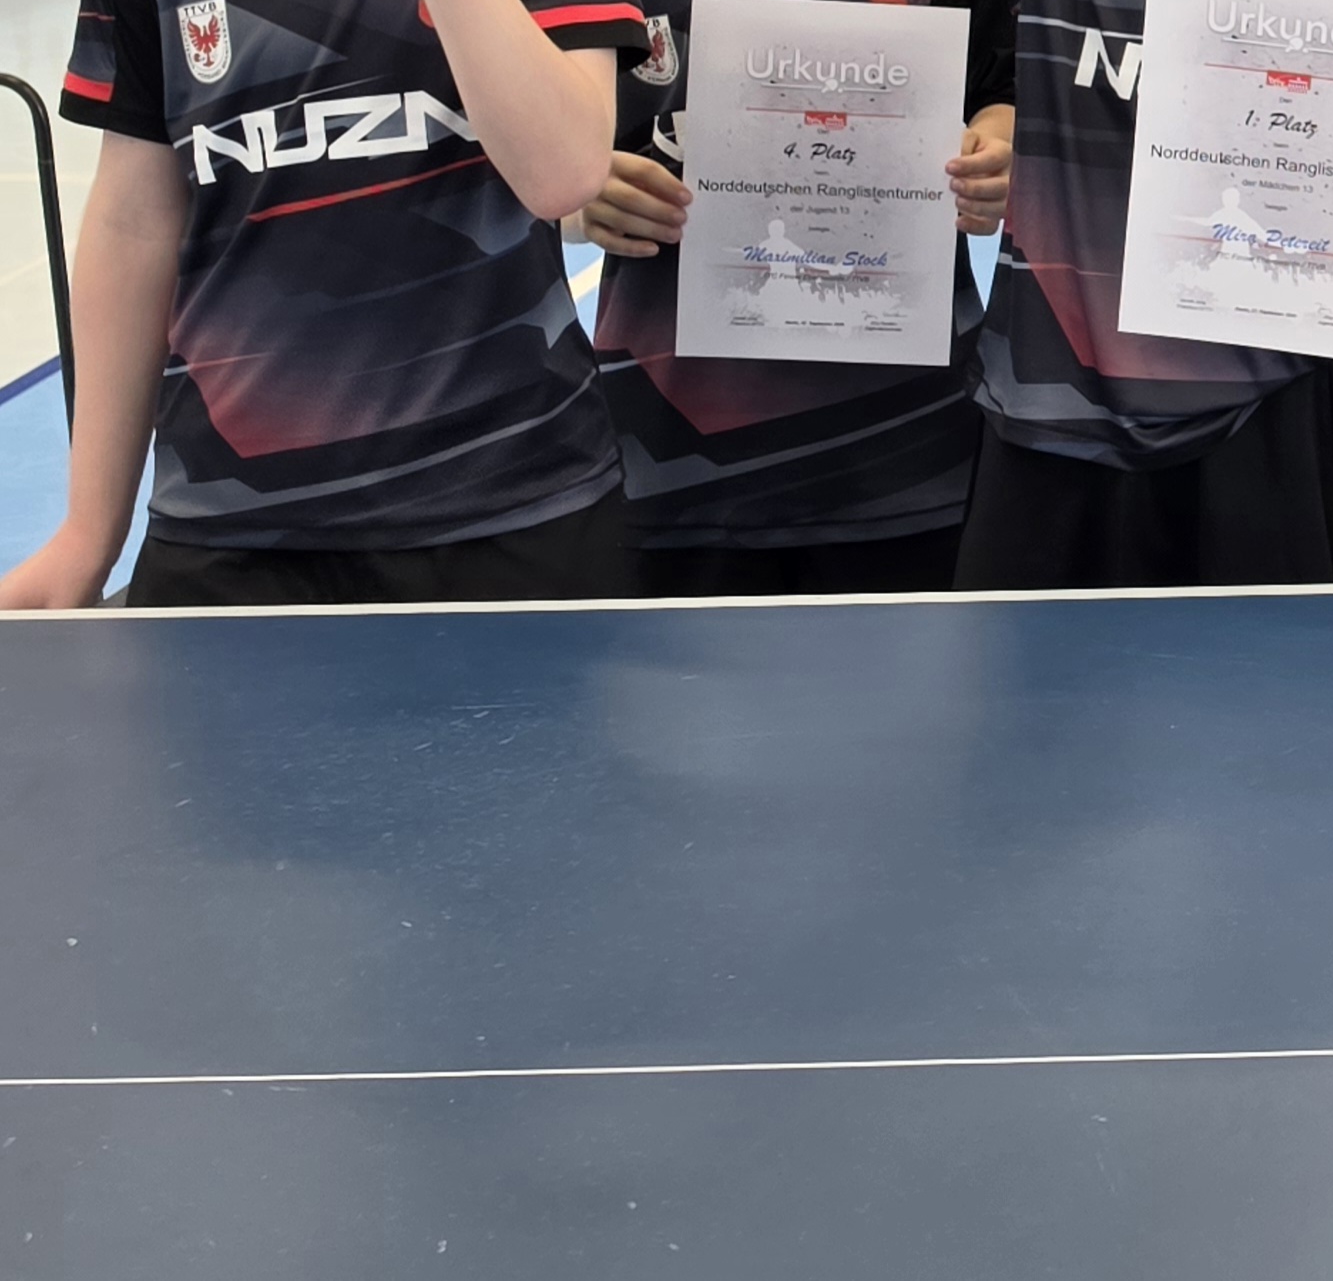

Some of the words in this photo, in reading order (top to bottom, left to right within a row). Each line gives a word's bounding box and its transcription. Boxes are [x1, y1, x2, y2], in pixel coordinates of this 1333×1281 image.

[746, 48, 910, 87] Urkunde
[1269, 112, 1319, 140] Platz
[810, 143, 857, 166] Platz
[1150, 144, 1271, 169] Norddeutschen
[697, 178, 812, 197] Norddeutschen
[817, 184, 943, 202] Ranglistenturnier
[743, 246, 836, 264] Maximilian
[842, 251, 888, 266] Stock
